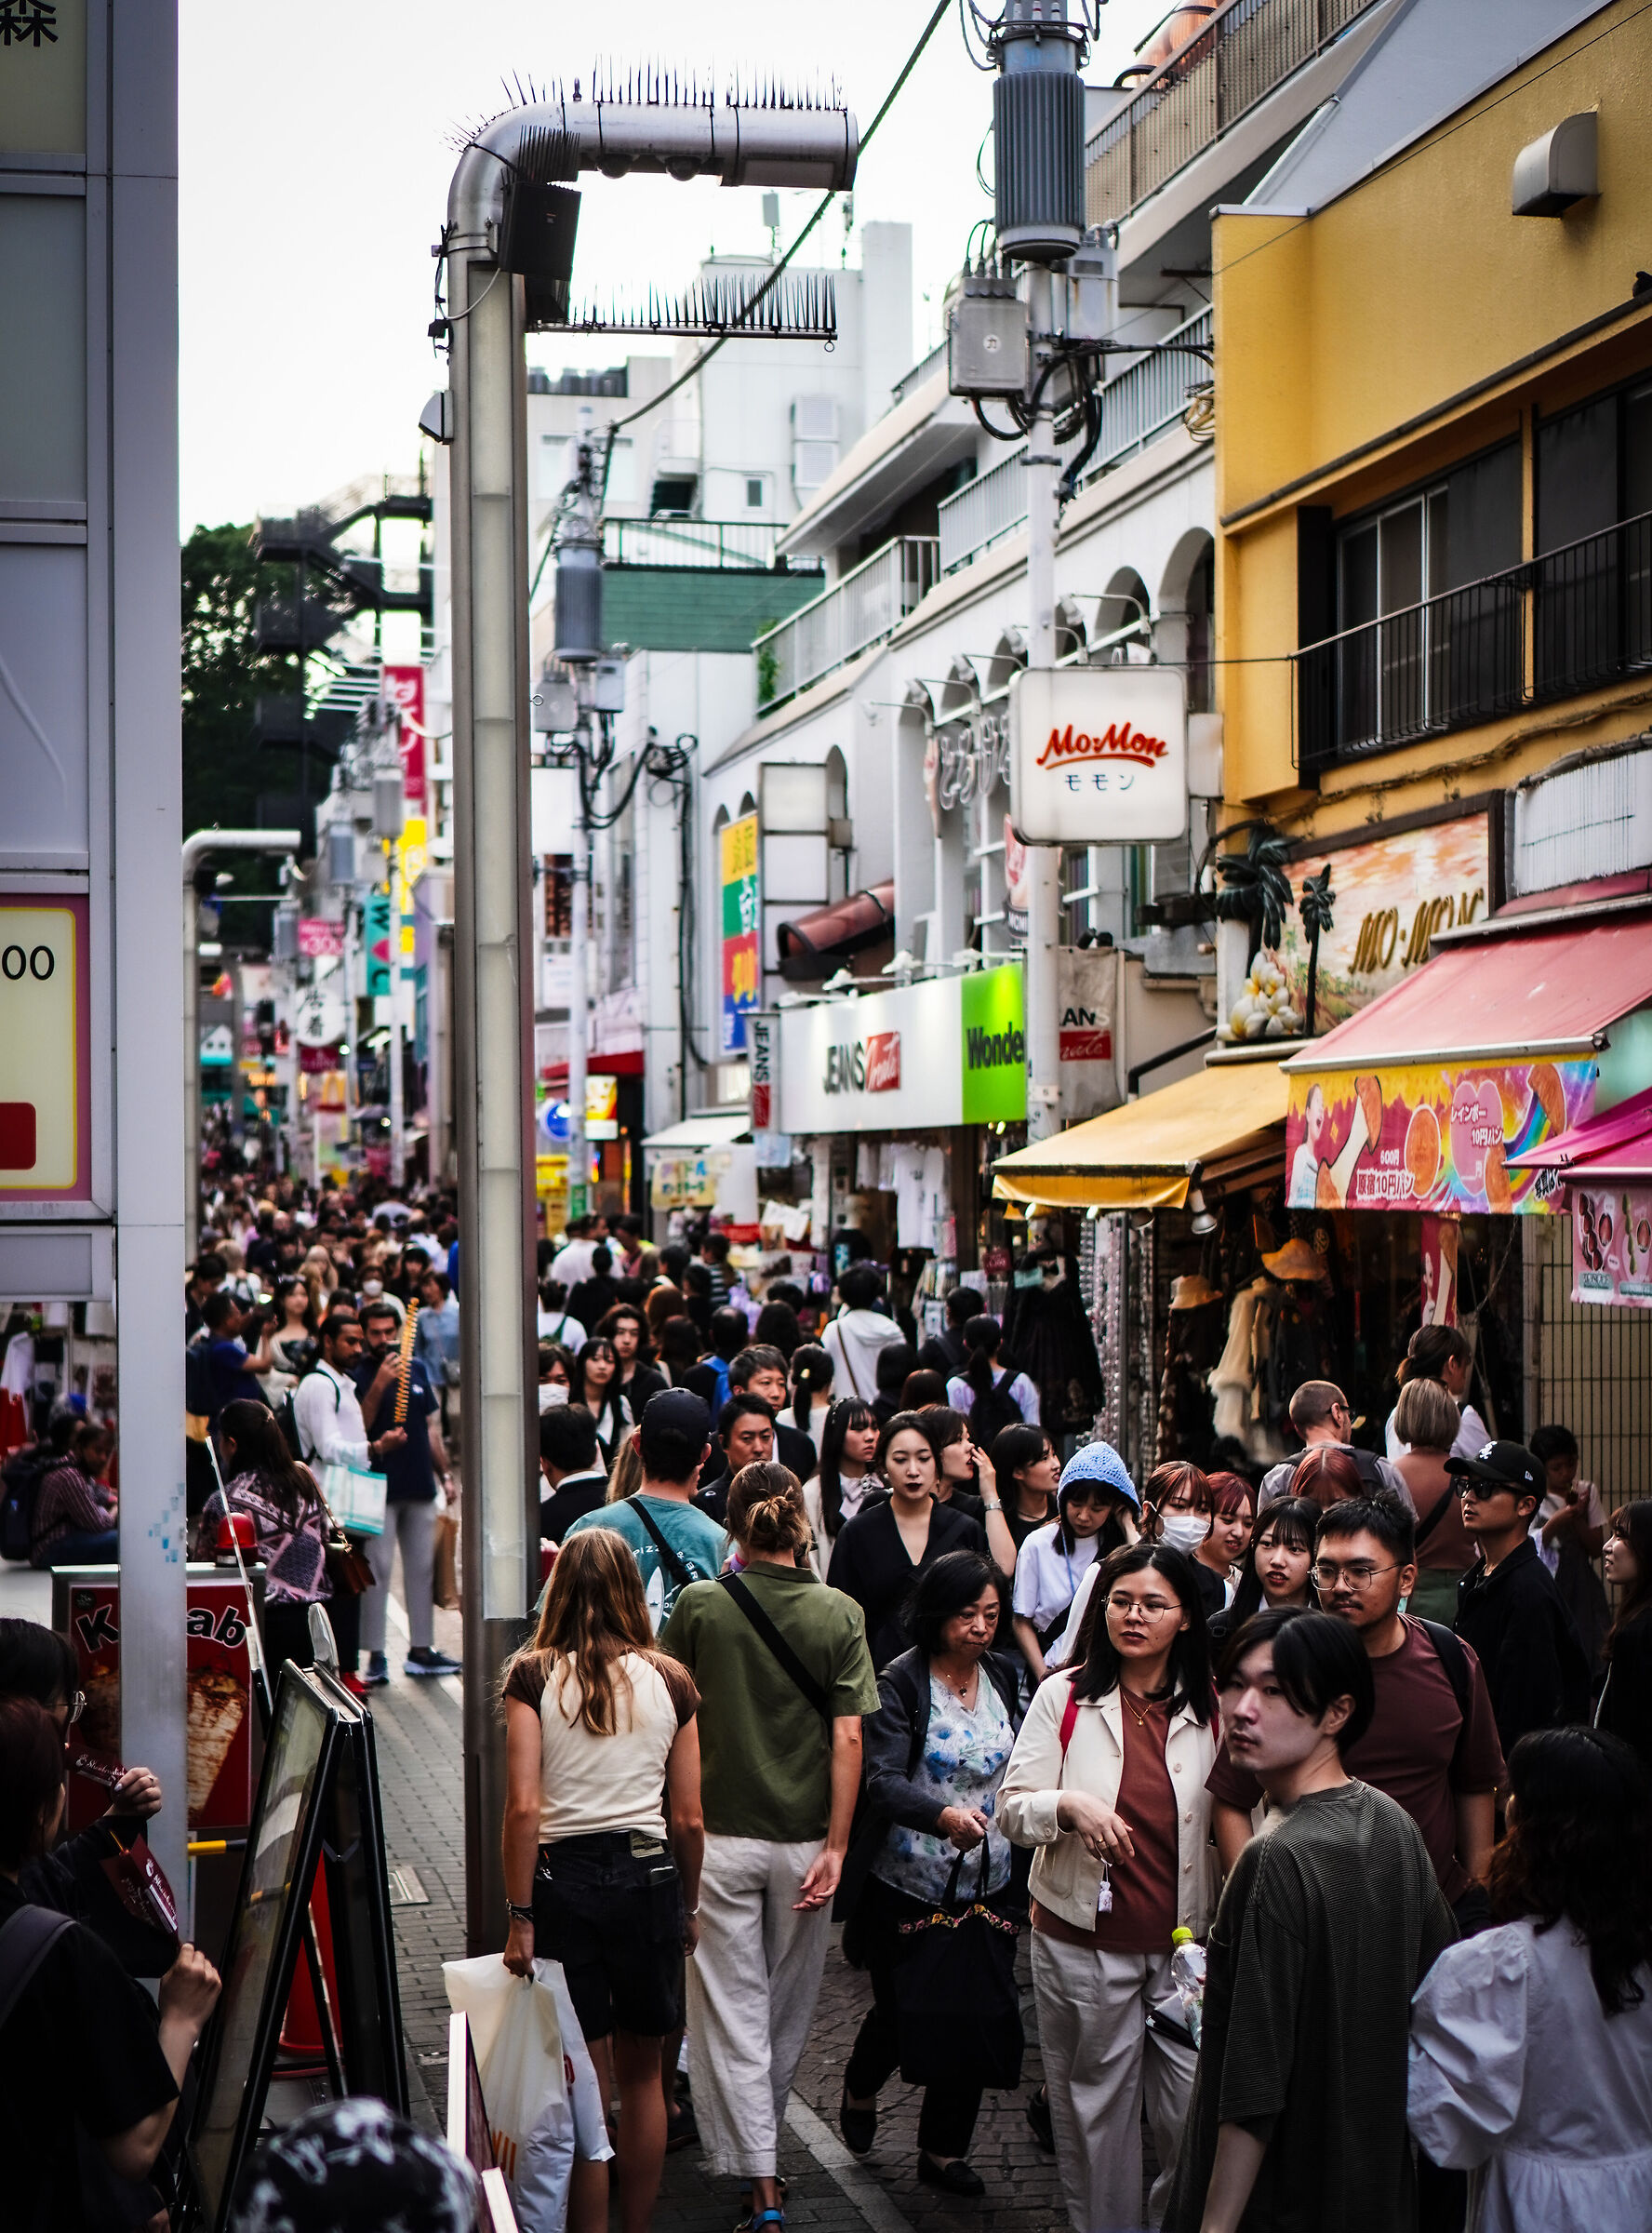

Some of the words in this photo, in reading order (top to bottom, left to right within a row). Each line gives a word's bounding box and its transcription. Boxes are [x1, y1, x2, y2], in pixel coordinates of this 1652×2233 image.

[0, 0, 59, 47] 森
[1064, 774, 1135, 791] モモン
[753, 1022, 769, 1081] JEANS
[1357, 1170, 1415, 1197] 原宿10円パン
[75, 1603, 246, 1653] Kab
